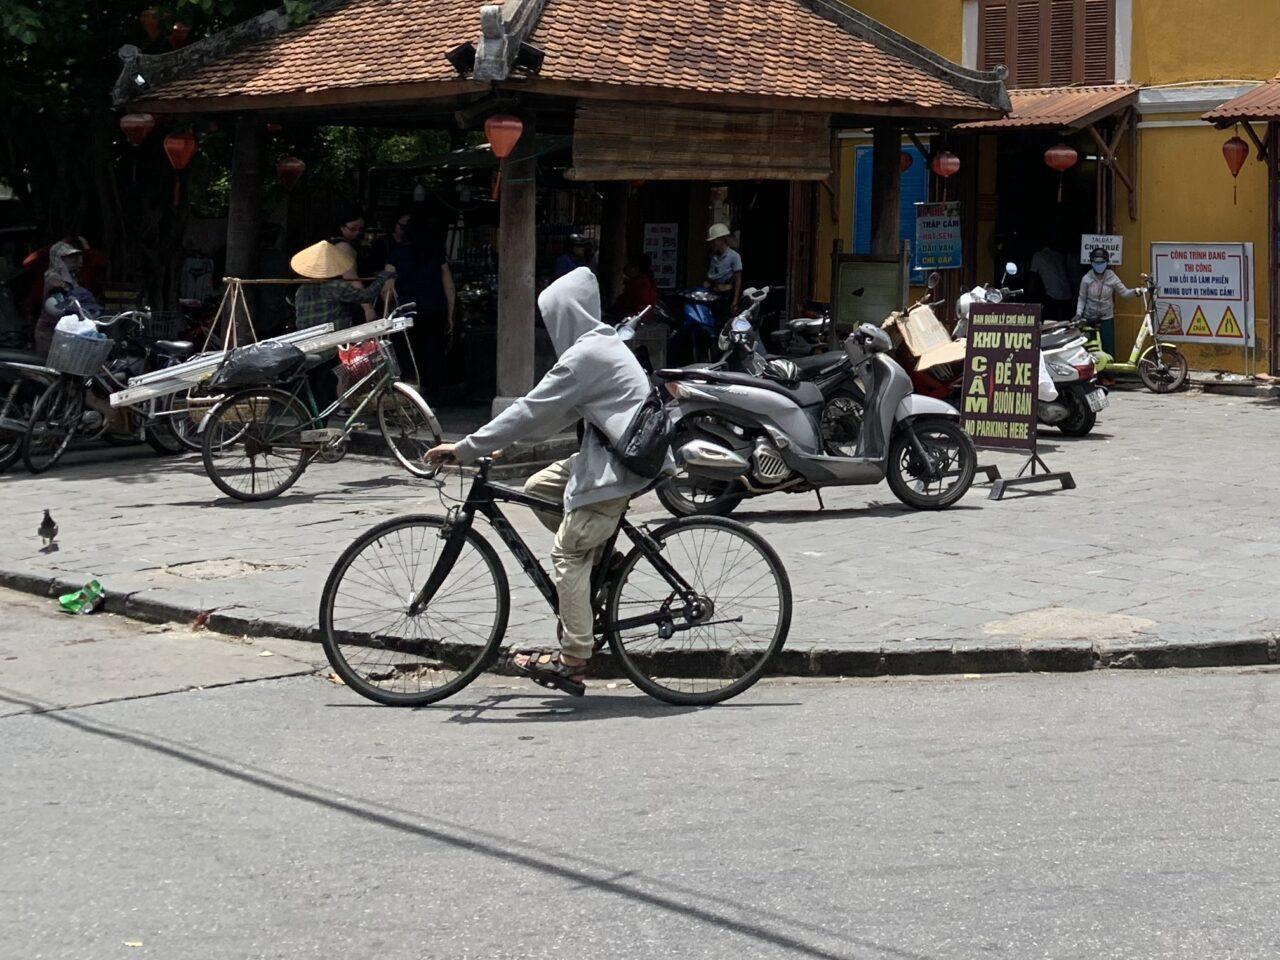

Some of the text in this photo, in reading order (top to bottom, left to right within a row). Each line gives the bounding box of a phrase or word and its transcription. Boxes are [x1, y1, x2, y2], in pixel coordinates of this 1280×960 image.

[1184, 263, 1194, 272] THI
[1169, 275, 1178, 283] XIN
[1164, 287, 1180, 295] MONG
[973, 331, 1032, 352] KHU VỰC
[995, 353, 1032, 385] ĐỂ XE
[1015, 387, 1032, 415] BÁN
[965, 419, 1030, 439] NO PARKING HERE
